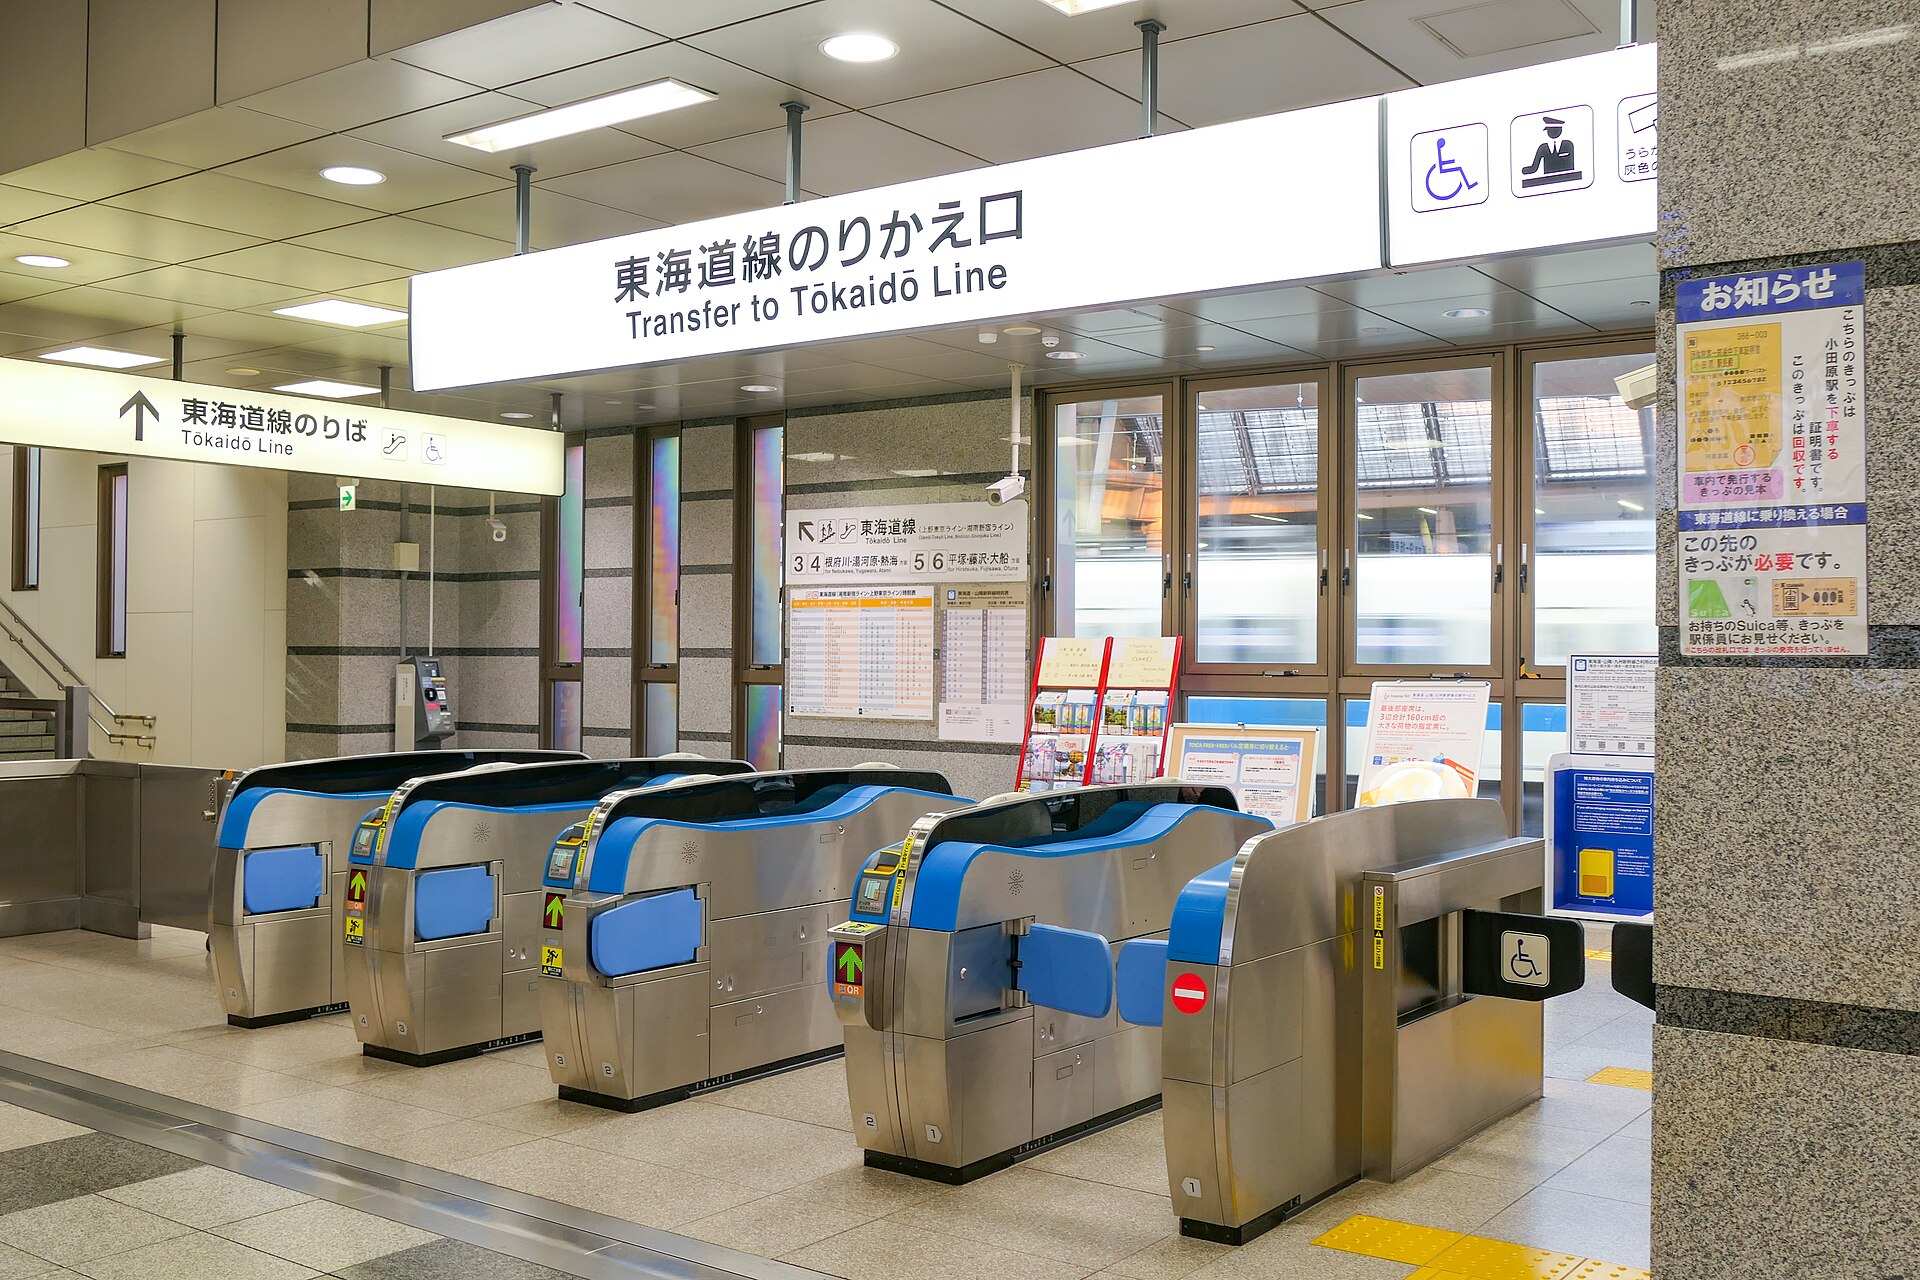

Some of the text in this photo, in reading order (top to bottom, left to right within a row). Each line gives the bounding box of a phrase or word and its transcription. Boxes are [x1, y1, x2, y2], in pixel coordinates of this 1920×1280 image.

[614, 190, 1022, 303] 東海道線のりかえ口
[1701, 268, 1837, 312] お知らせ
[626, 262, 1007, 339] Transfer to Tōkaidō Line
[1842, 309, 1856, 417] こちらのきっぷは
[1825, 337, 1839, 460] 小田原駅を下車する
[181, 398, 367, 442] 東海道線のりば
[1792, 355, 1806, 493] このきっぷは回収です。
[182, 430, 293, 456] Tōkaidō Line
[1809, 422, 1823, 492] 証明書です。
[1694, 473, 1772, 486] 車内で発行する
[1700, 484, 1766, 497] きっぷの見本
[1694, 507, 1848, 525] 東海道線に乗り換える場合
[860, 518, 916, 536] 東海道線
[1684, 535, 1757, 552] この先の
[794, 556, 803, 572] 3
[810, 556, 820, 572] 4
[914, 554, 924, 570] 5
[933, 553, 943, 570] 6
[1684, 552, 1841, 573] きっぷが必要です。
[1688, 619, 1844, 632] お持ちのSuica等、きっぷを
[1689, 633, 1830, 645] 駅係員にお見せください。
[847, 985, 859, 995] QR
[557, 1056, 611, 1074] 3 2
[866, 1117, 936, 1139] 2 1
[1188, 1182, 1194, 1193] 1
